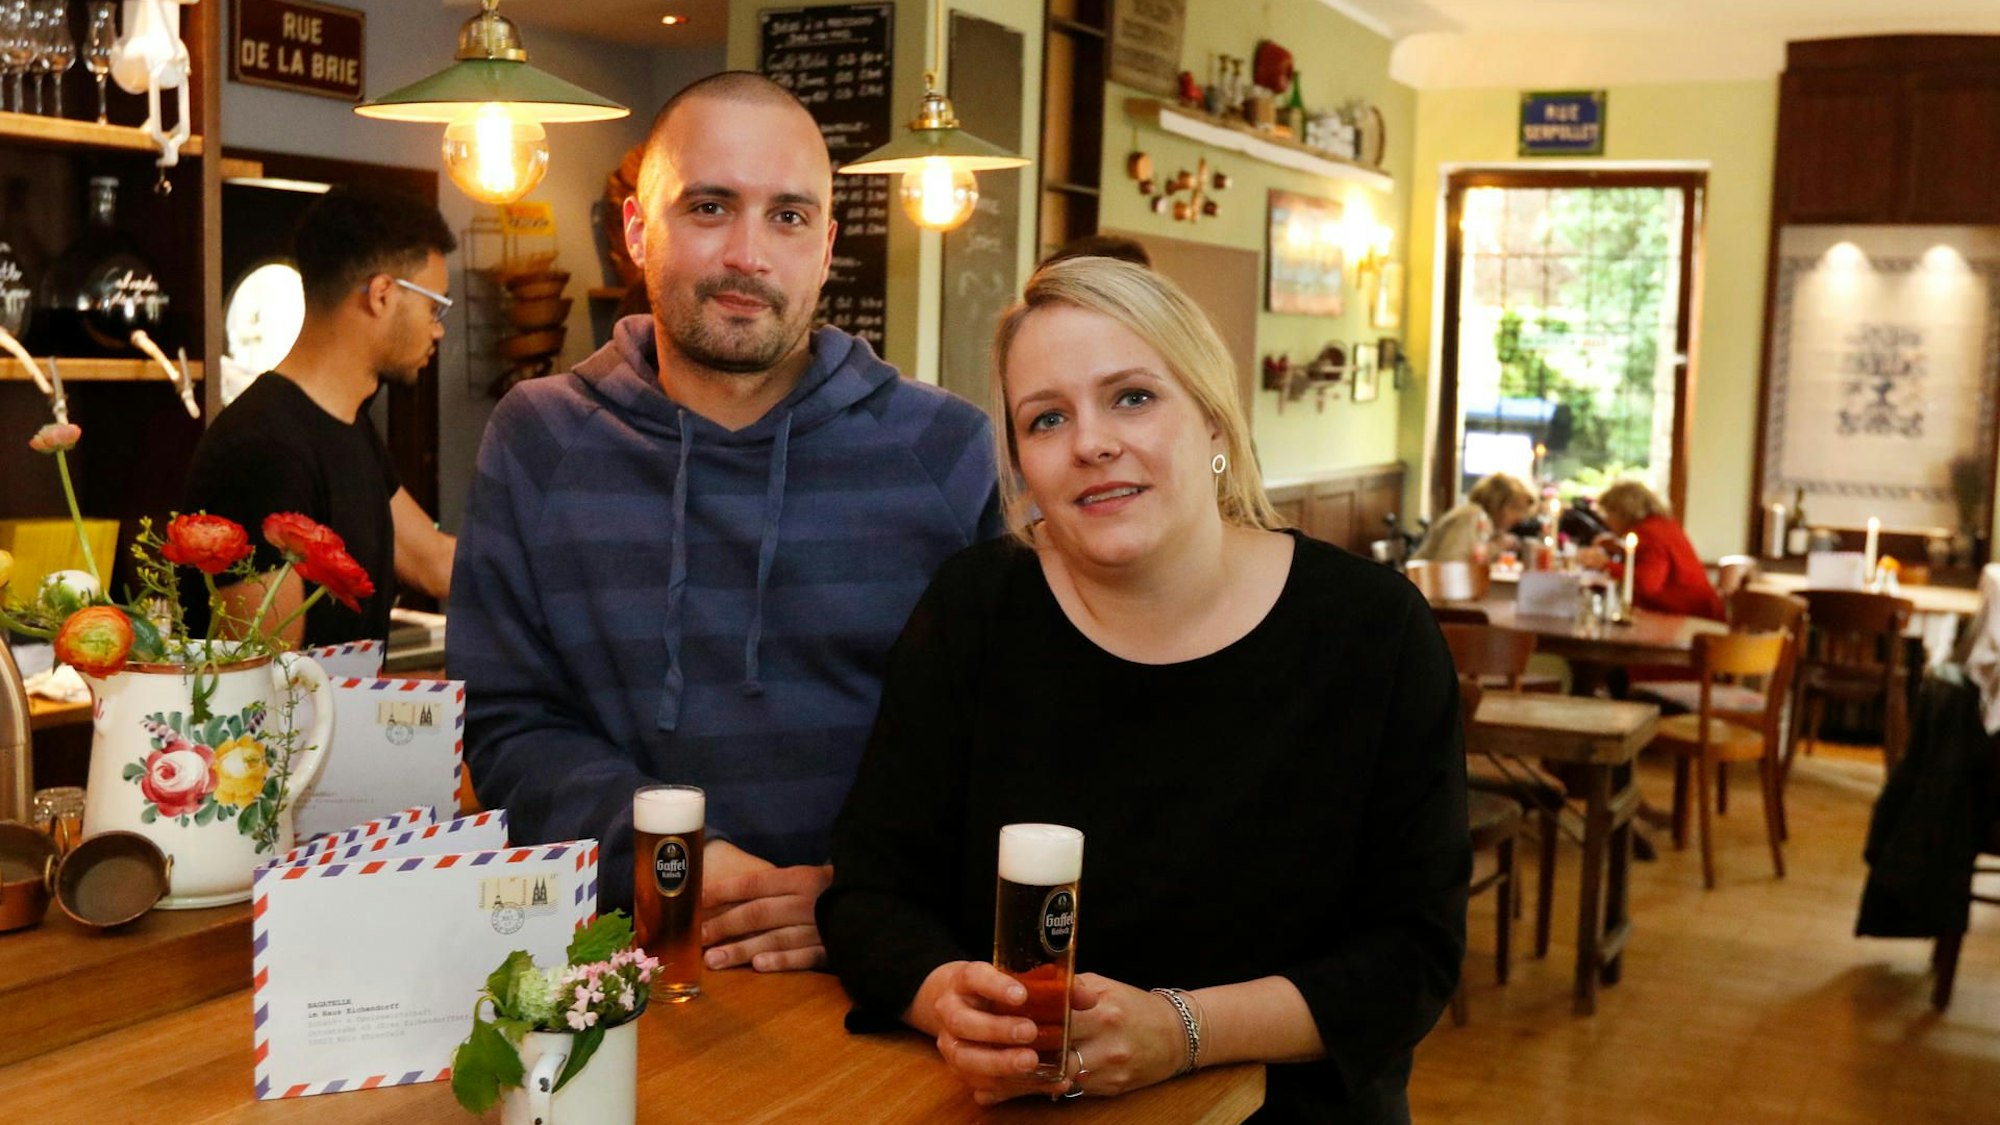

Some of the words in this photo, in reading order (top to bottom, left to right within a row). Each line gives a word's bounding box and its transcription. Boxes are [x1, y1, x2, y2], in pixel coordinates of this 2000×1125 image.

[282, 11, 322, 46] RUE
[242, 38, 270, 69] DE
[277, 45, 305, 76] LA
[311, 52, 359, 86] BRIE
[1545, 103, 1578, 121] RUE
[656, 859, 686, 871] Gaffel
[1046, 912, 1074, 927] Gaffel
